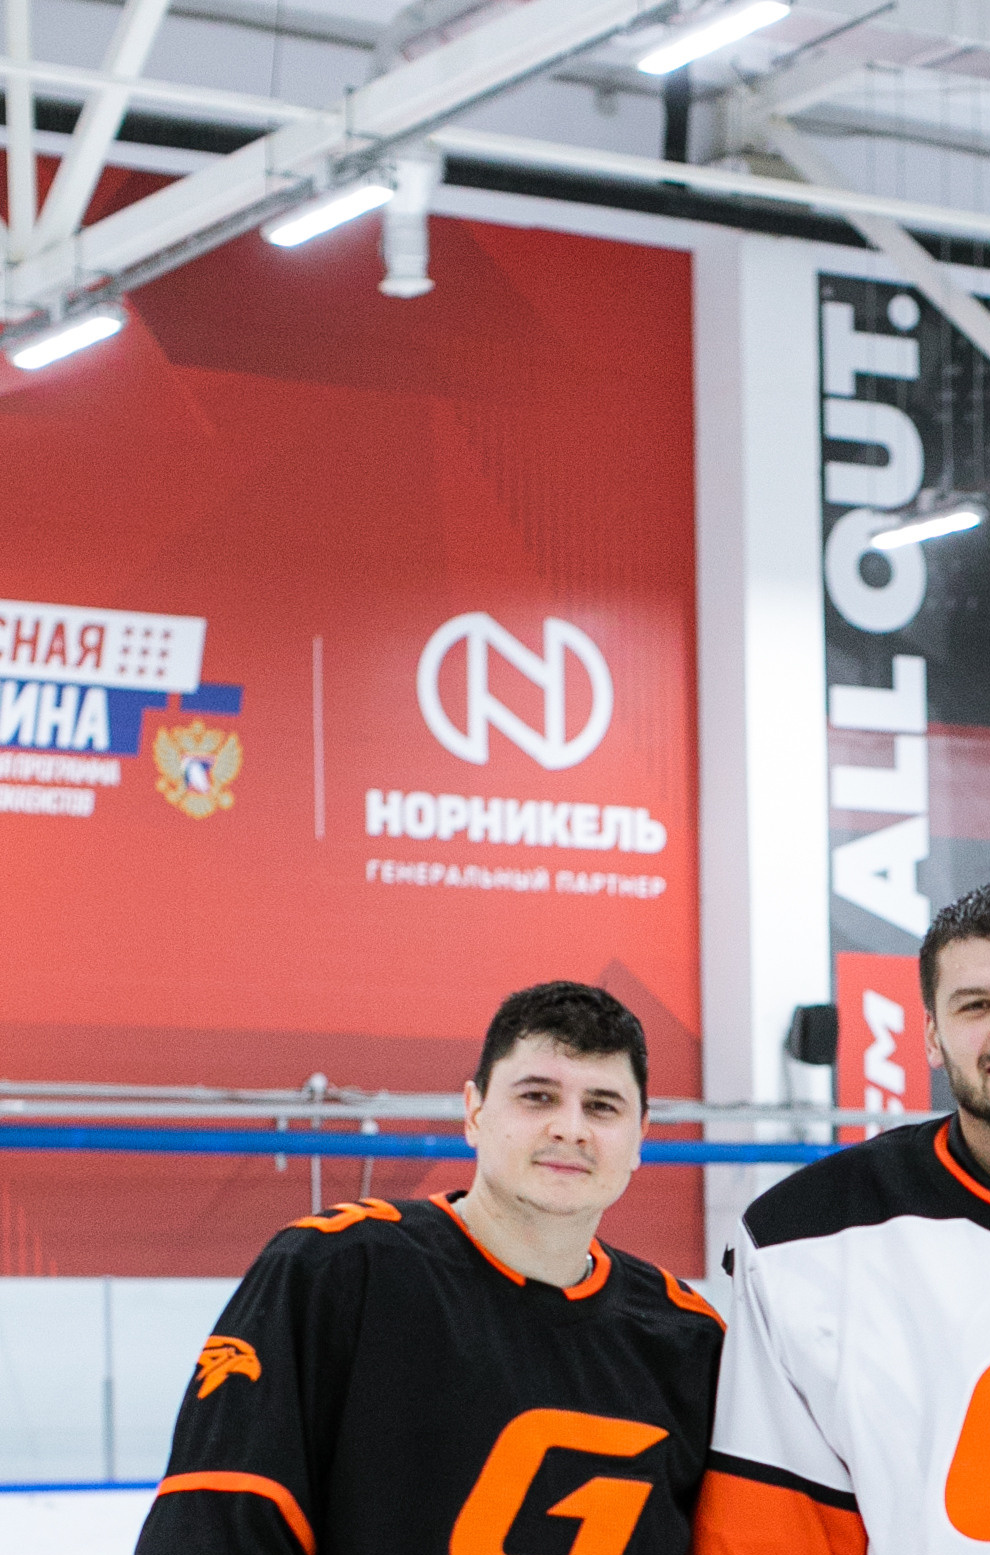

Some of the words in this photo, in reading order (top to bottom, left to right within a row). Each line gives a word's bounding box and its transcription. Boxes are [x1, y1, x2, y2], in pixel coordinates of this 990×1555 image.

[822, 293, 928, 634] OUT.
[365, 788, 668, 855] НОРНИКЕЛЬ
[365, 858, 549, 893] ГЕНЕРАЛЬНЫЙ
[555, 869, 668, 900] ПАРТНЕР
[830, 654, 931, 938] ALL
